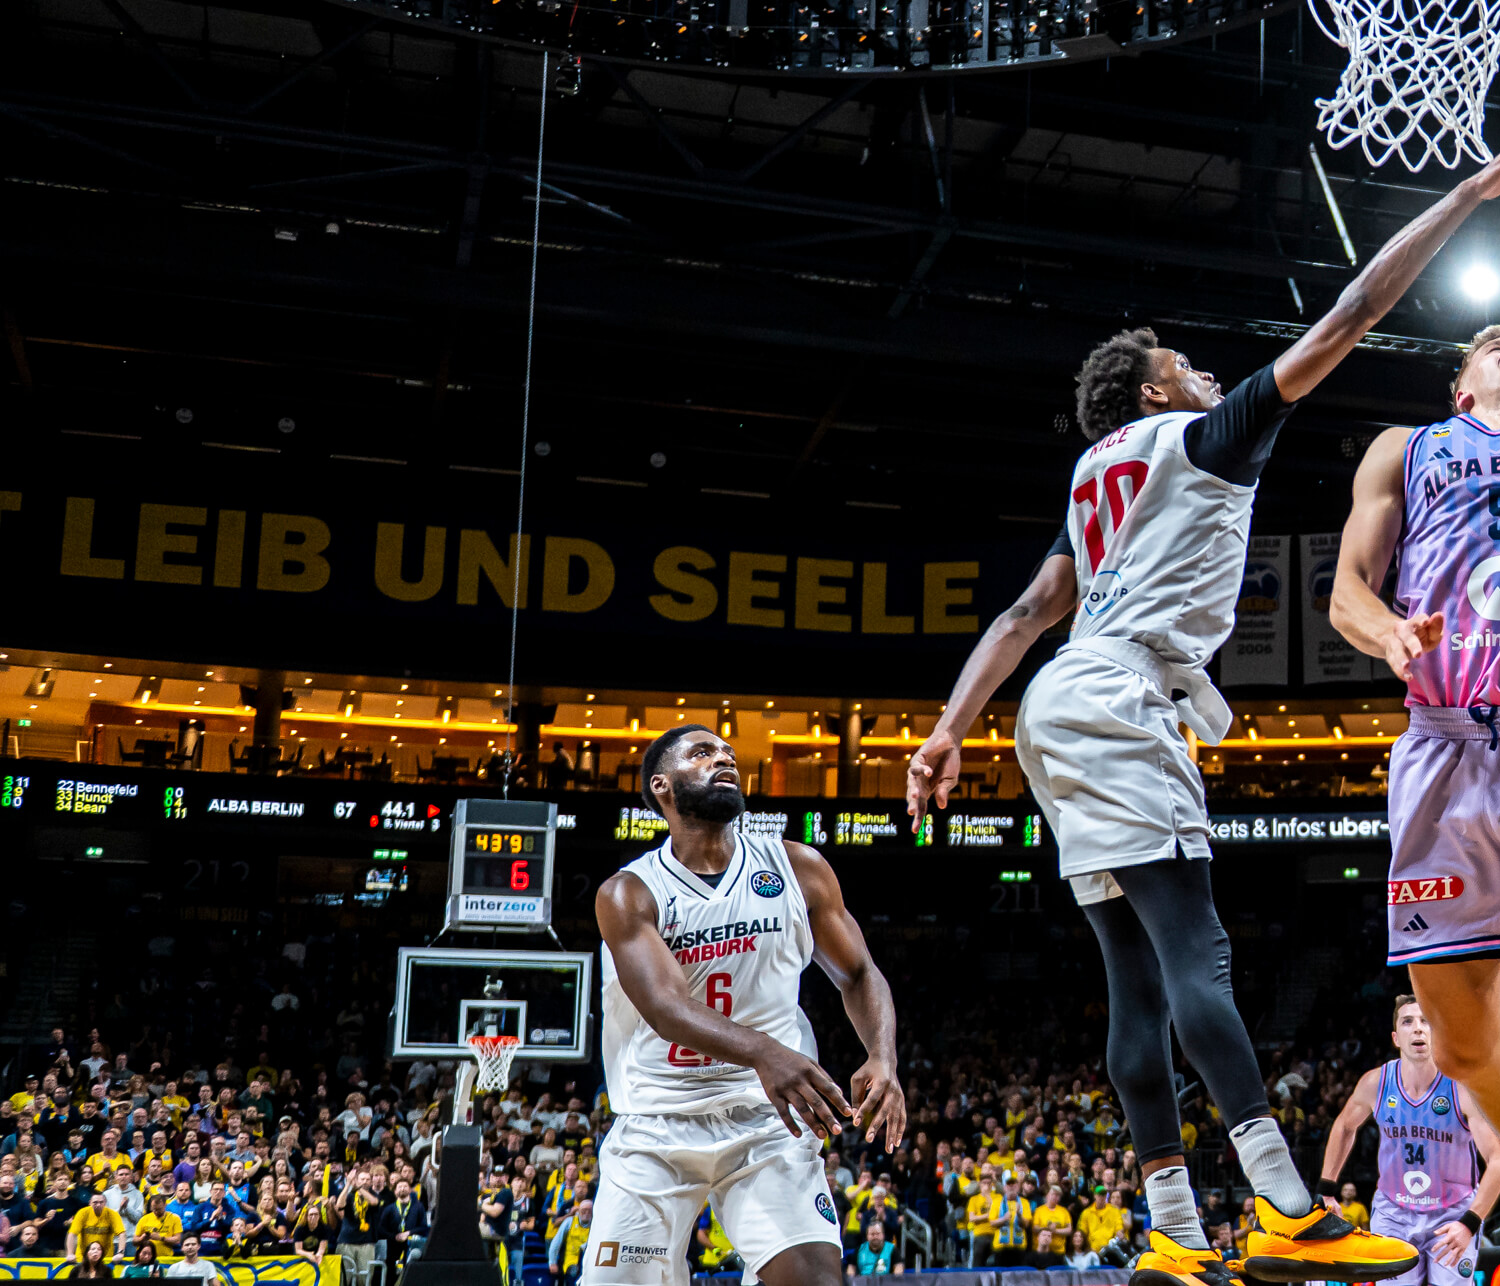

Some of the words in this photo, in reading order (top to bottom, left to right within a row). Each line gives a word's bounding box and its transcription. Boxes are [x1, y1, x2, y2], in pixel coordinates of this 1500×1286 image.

[1423, 458, 1483, 508] ALBA
[60, 496, 332, 592] LEIB
[373, 521, 616, 612] UND
[649, 545, 980, 634] SEELE
[57, 780, 74, 791] 22
[76, 781, 138, 796] Bennefeld
[56, 790, 73, 801] 33
[75, 792, 113, 804] Hundt
[56, 800, 72, 811] 34
[74, 802, 106, 813] Bean
[208, 799, 249, 813] ALBA
[250, 801, 304, 817] BERLIN
[334, 802, 357, 818] 67
[743, 811, 787, 822] Svoboda
[853, 813, 889, 823] Sehnal
[950, 815, 963, 825] 40
[965, 815, 1014, 827] Lawrence
[743, 821, 786, 831] Dreamer
[1208, 819, 1248, 838] kets
[1253, 818, 1268, 837] &
[1273, 817, 1325, 837] Infos:
[950, 834, 962, 845] 77
[964, 834, 1003, 845] Hruban
[511, 860, 529, 890] 6
[465, 896, 537, 912] interzero
[707, 973, 733, 1017] 6
[1383, 1126, 1409, 1140] ALBA
[1411, 1125, 1453, 1144] BERLIN
[1405, 1143, 1425, 1166] 34
[1395, 1192, 1441, 1205] Schindler
[622, 1245, 668, 1255] PERINVEST
[620, 1255, 653, 1264] GROUP
